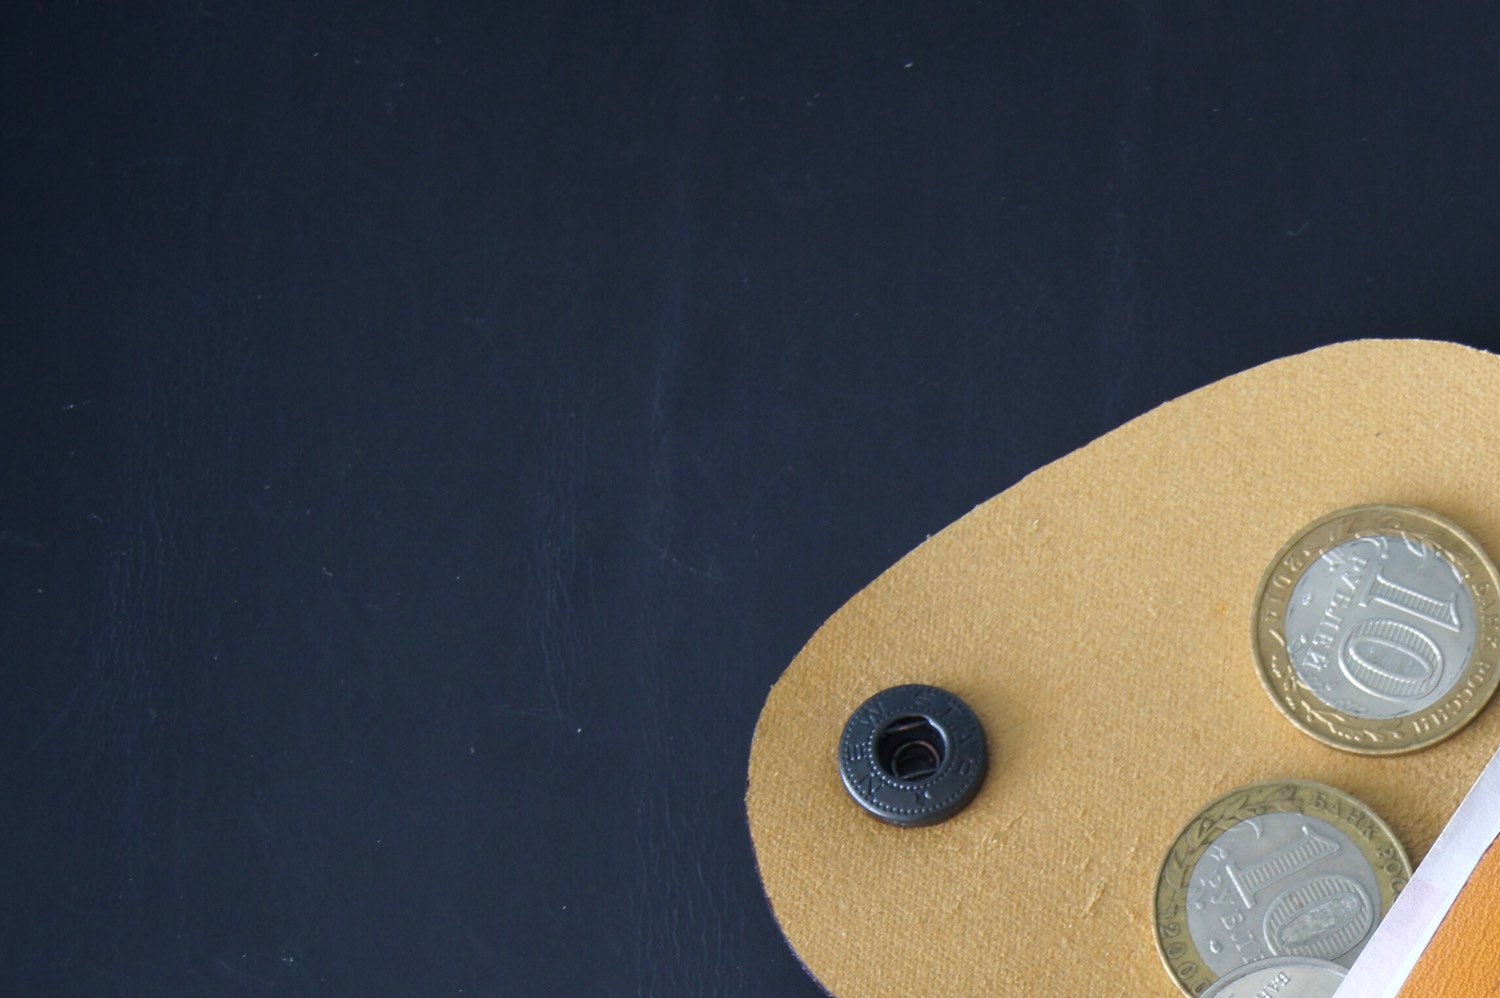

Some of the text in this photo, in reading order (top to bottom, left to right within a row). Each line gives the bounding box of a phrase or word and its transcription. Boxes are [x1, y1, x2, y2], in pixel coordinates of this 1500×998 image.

[1302, 555, 1370, 672] РУБЛЕЙ
[1338, 564, 1461, 702] 10
[1411, 582, 1500, 735] БАНК РОССИИ
[1313, 790, 1380, 842] БАНК
[1225, 825, 1374, 960] 10
